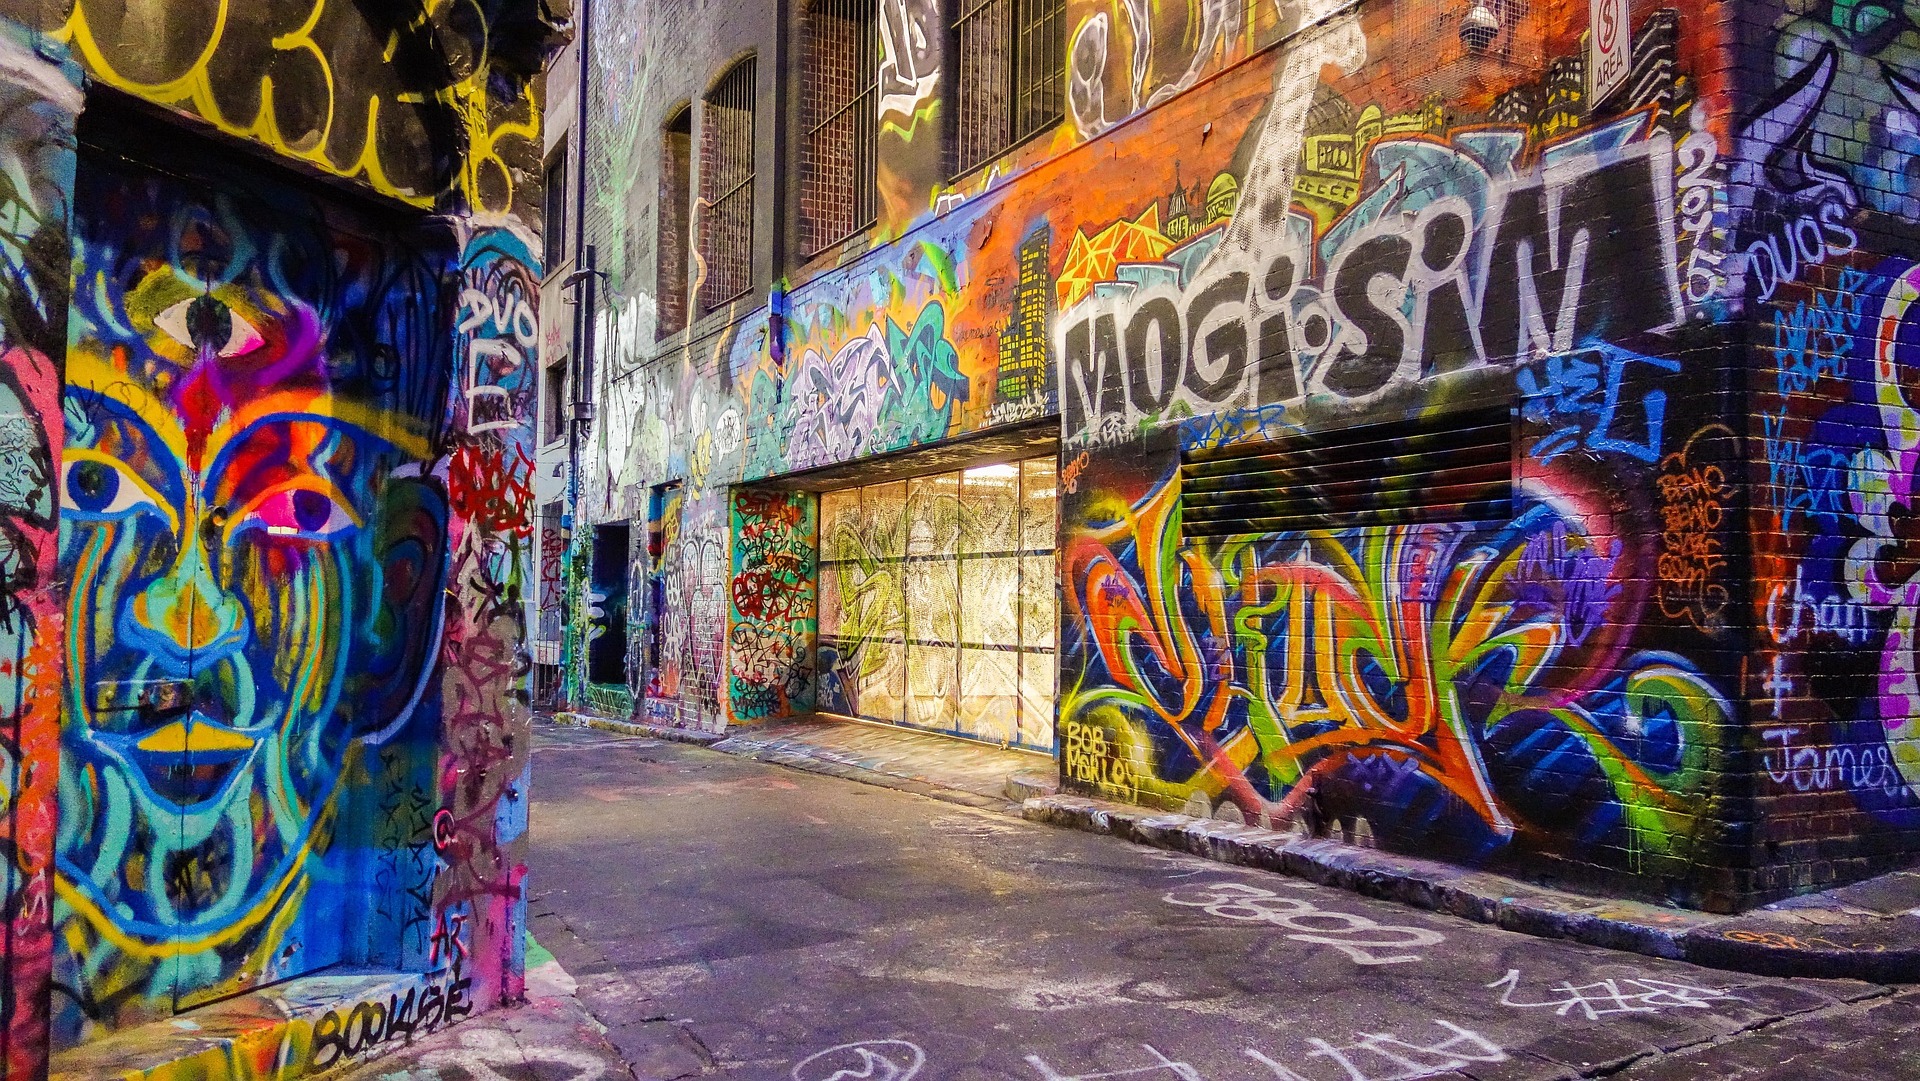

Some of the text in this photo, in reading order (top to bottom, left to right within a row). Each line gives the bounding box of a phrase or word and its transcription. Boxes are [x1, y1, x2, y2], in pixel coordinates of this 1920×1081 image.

[1596, 45, 1623, 91] AREA
[1743, 201, 1857, 304] DUOS
[1067, 721, 1107, 757] BOB
